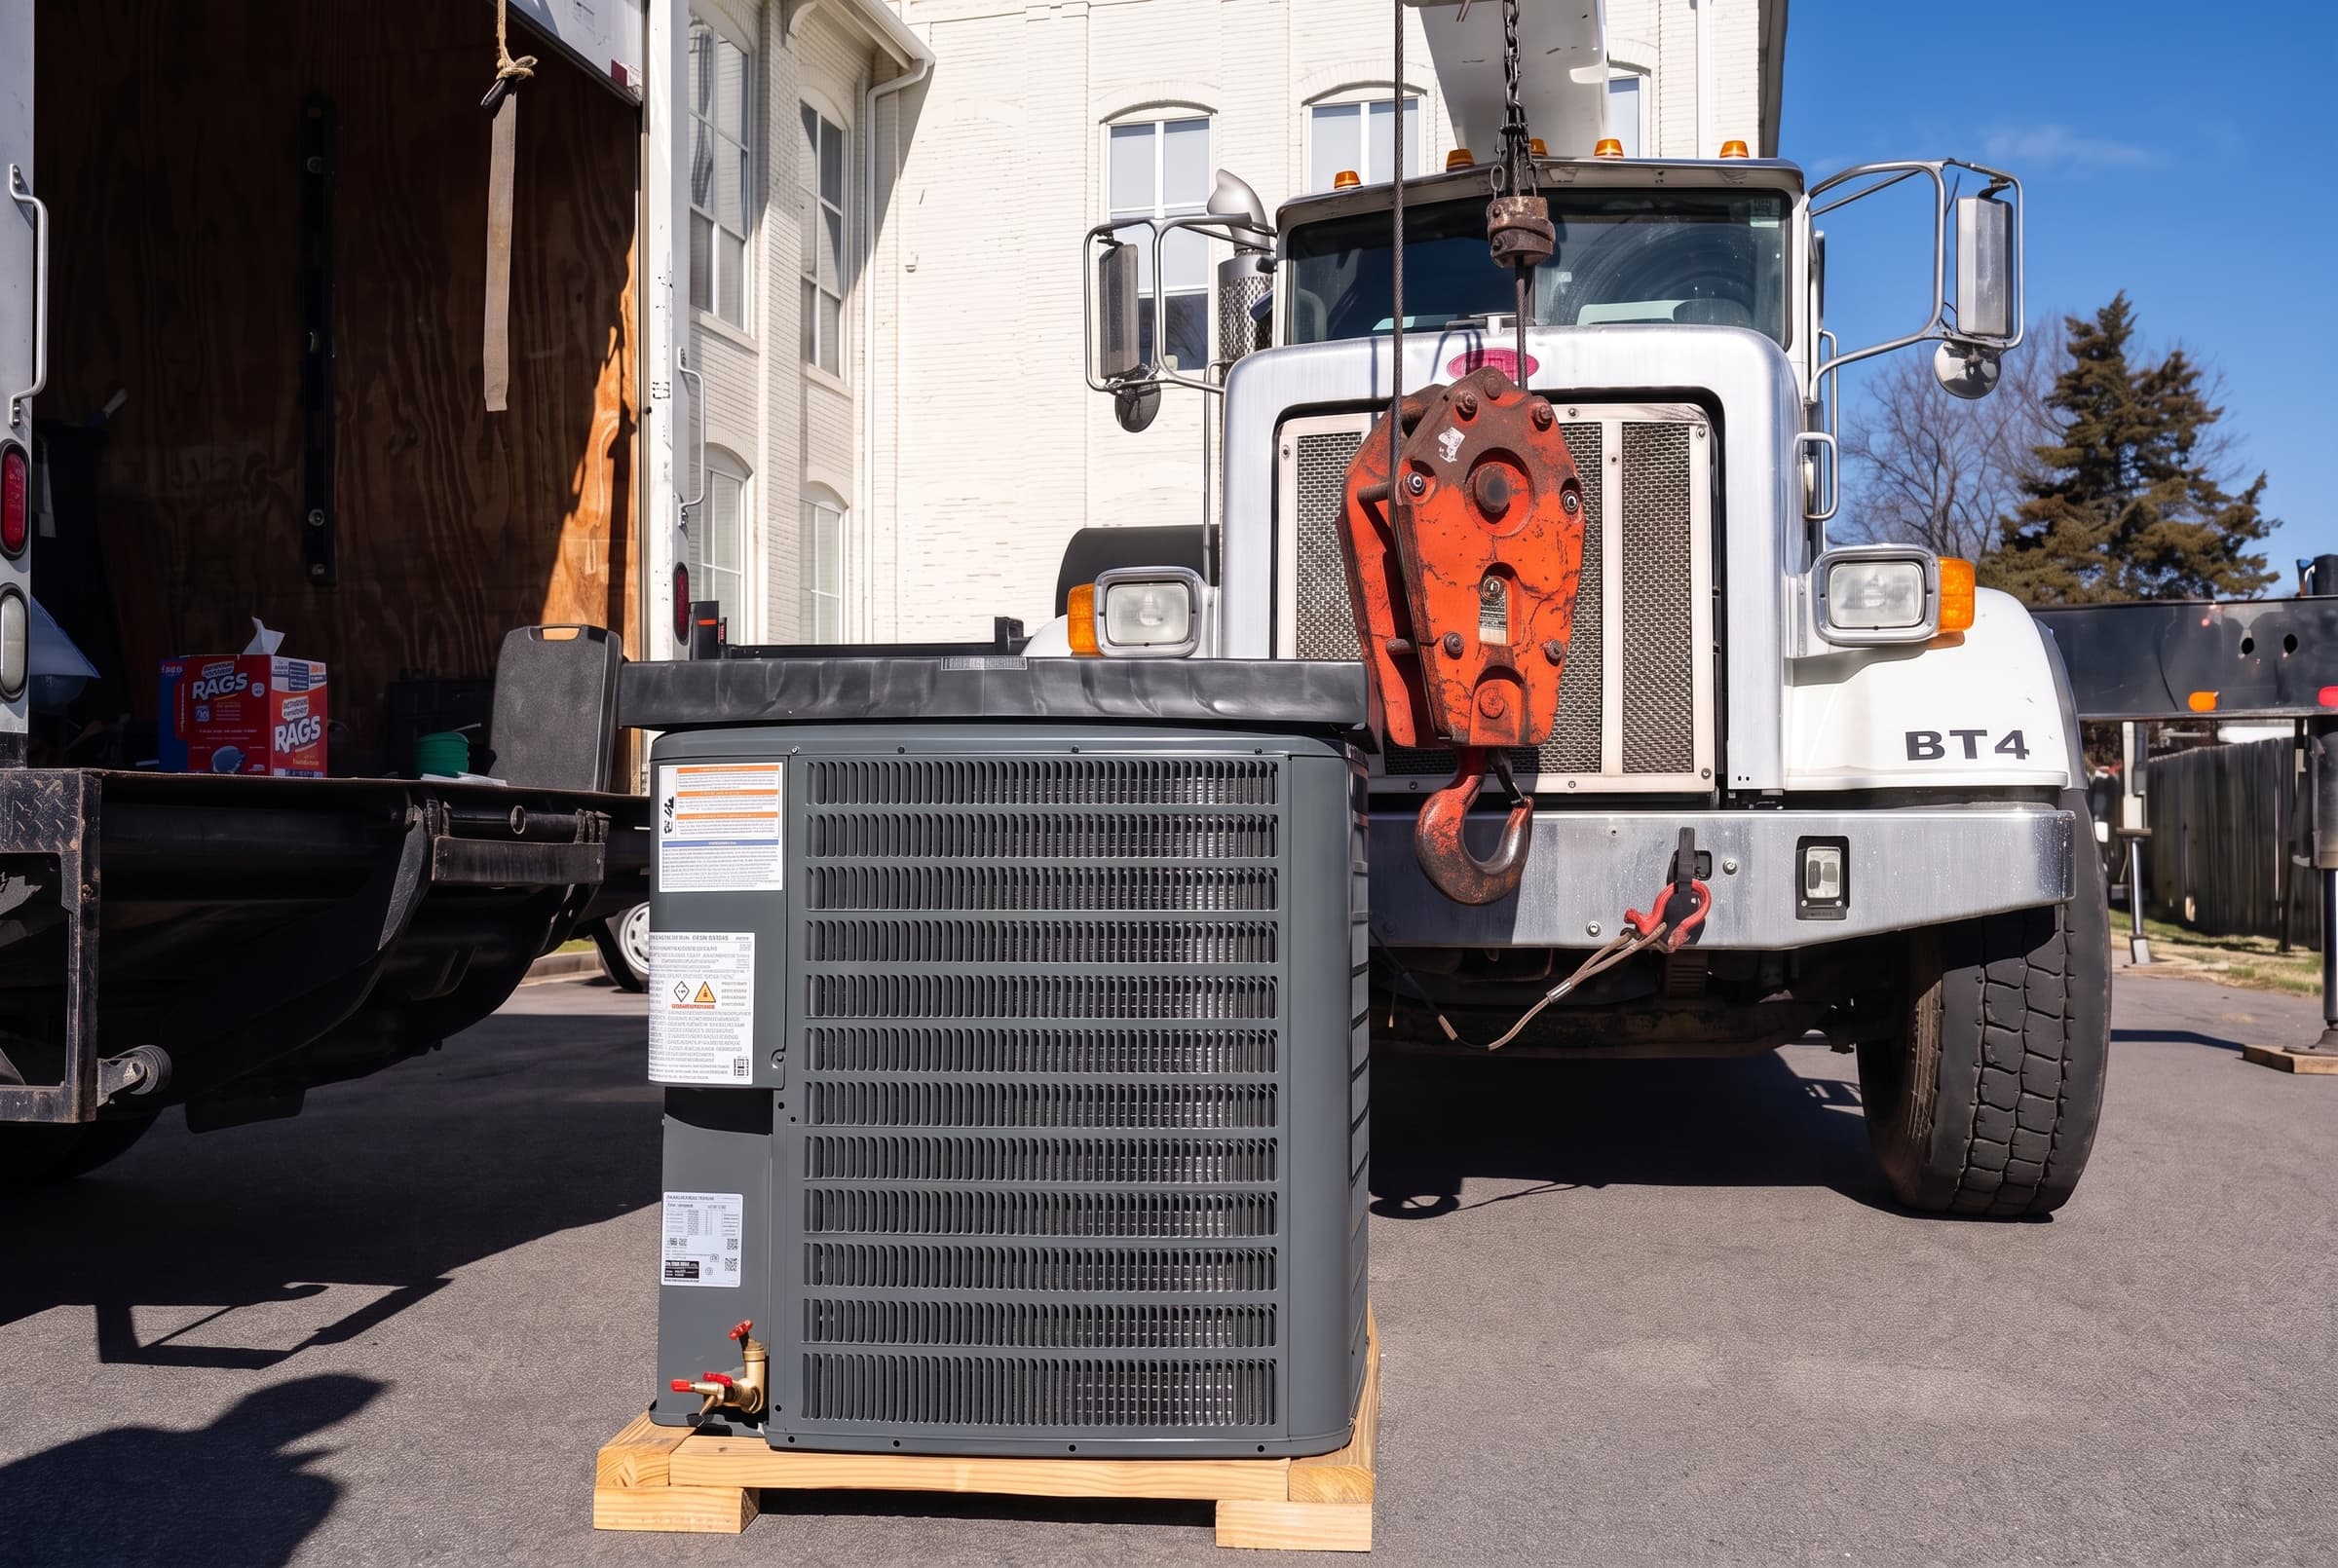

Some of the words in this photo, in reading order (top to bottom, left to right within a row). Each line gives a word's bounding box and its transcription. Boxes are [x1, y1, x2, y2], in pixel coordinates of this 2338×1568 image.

[192, 672, 247, 700] RAGS
[275, 716, 321, 754] RAGS
[1905, 729, 2029, 761] BT4
